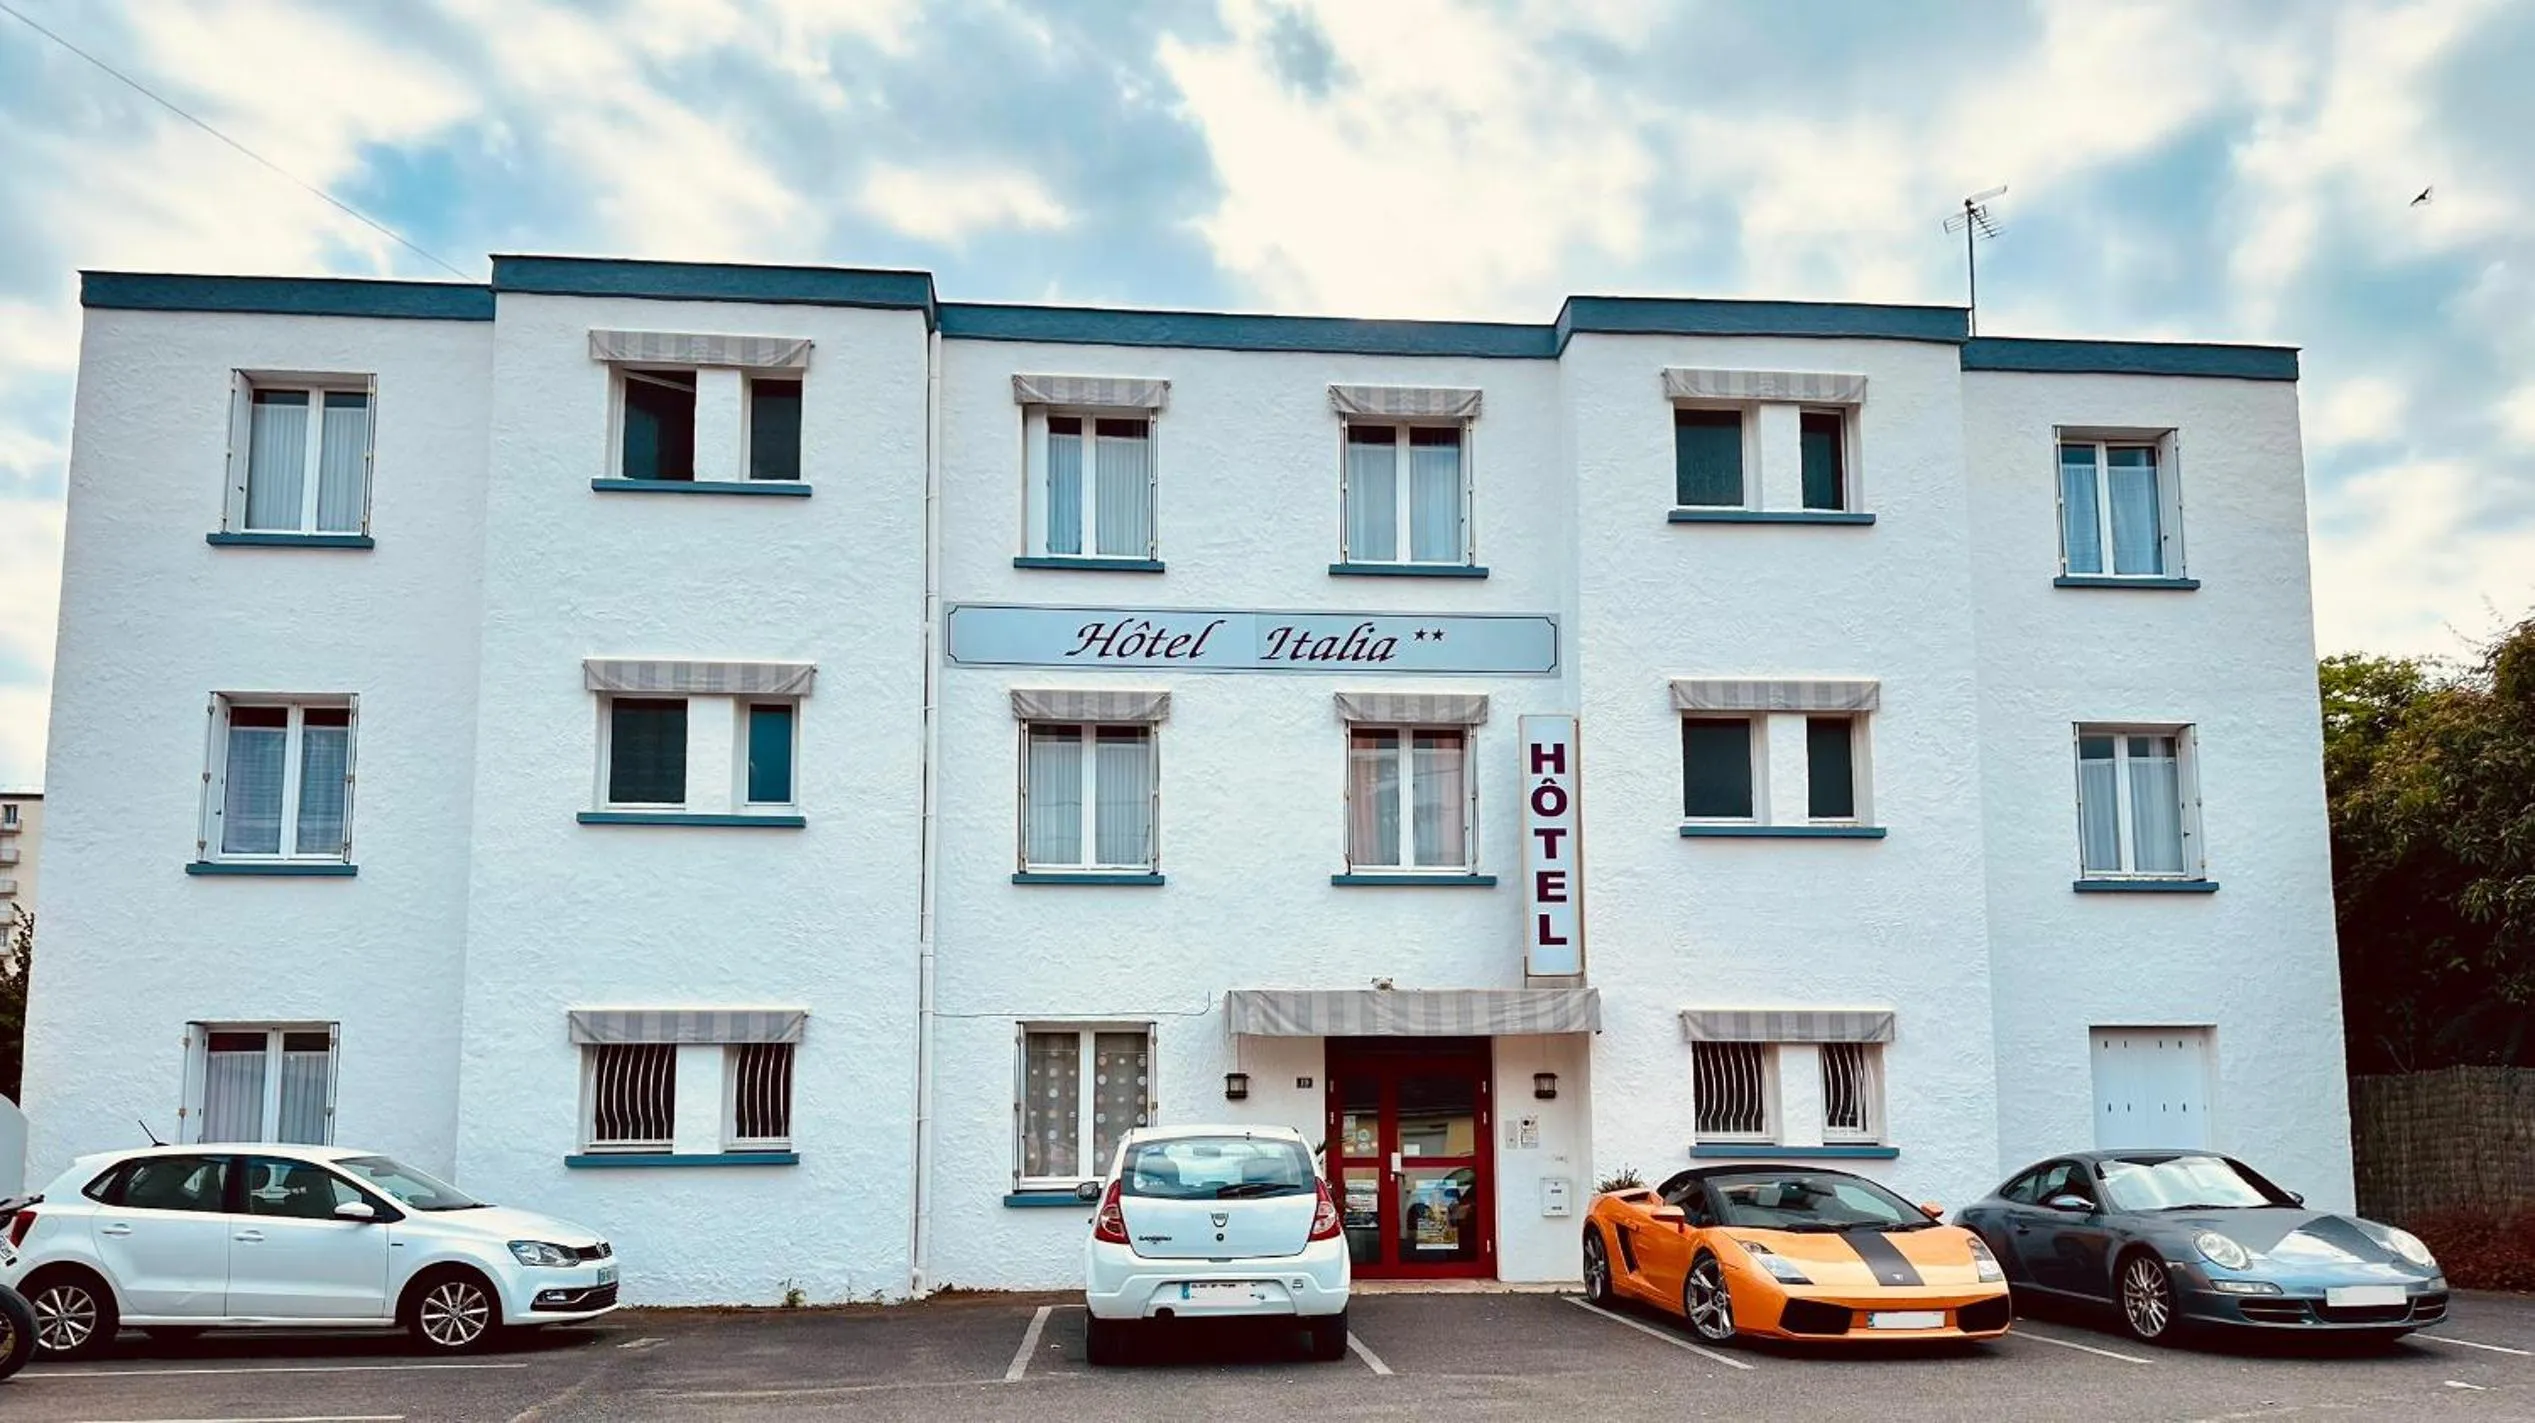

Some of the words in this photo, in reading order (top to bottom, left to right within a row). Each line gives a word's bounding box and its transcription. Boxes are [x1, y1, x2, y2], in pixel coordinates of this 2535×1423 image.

[1065, 618, 1227, 660] Hôtel
[1259, 621, 1399, 663] Italia
[1530, 743, 1568, 945] HÔTEL
